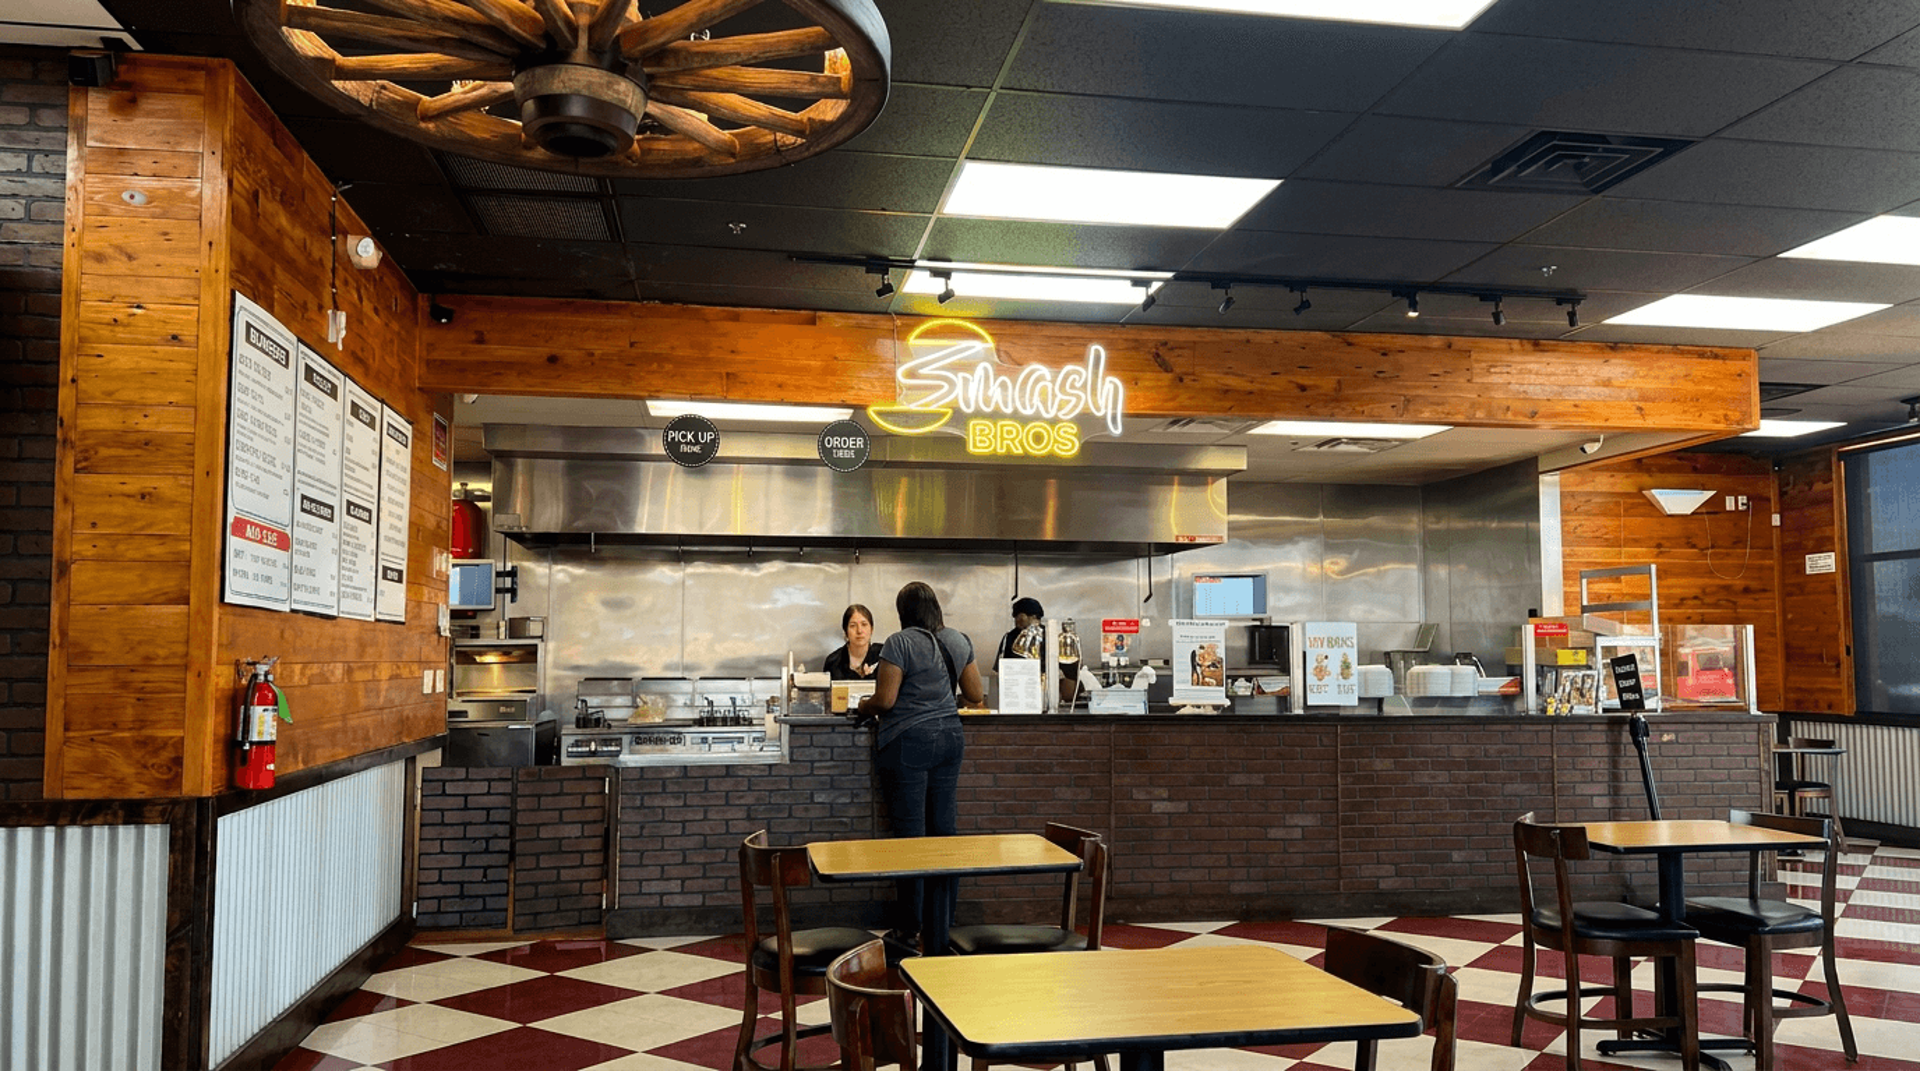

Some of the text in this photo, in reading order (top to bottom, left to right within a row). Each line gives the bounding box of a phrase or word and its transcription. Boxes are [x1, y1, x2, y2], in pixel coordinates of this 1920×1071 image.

[896, 340, 1124, 435] Smash
[668, 430, 715, 443] PICK UP
[824, 436, 864, 449] ORDER
[967, 419, 1081, 457] BROS
